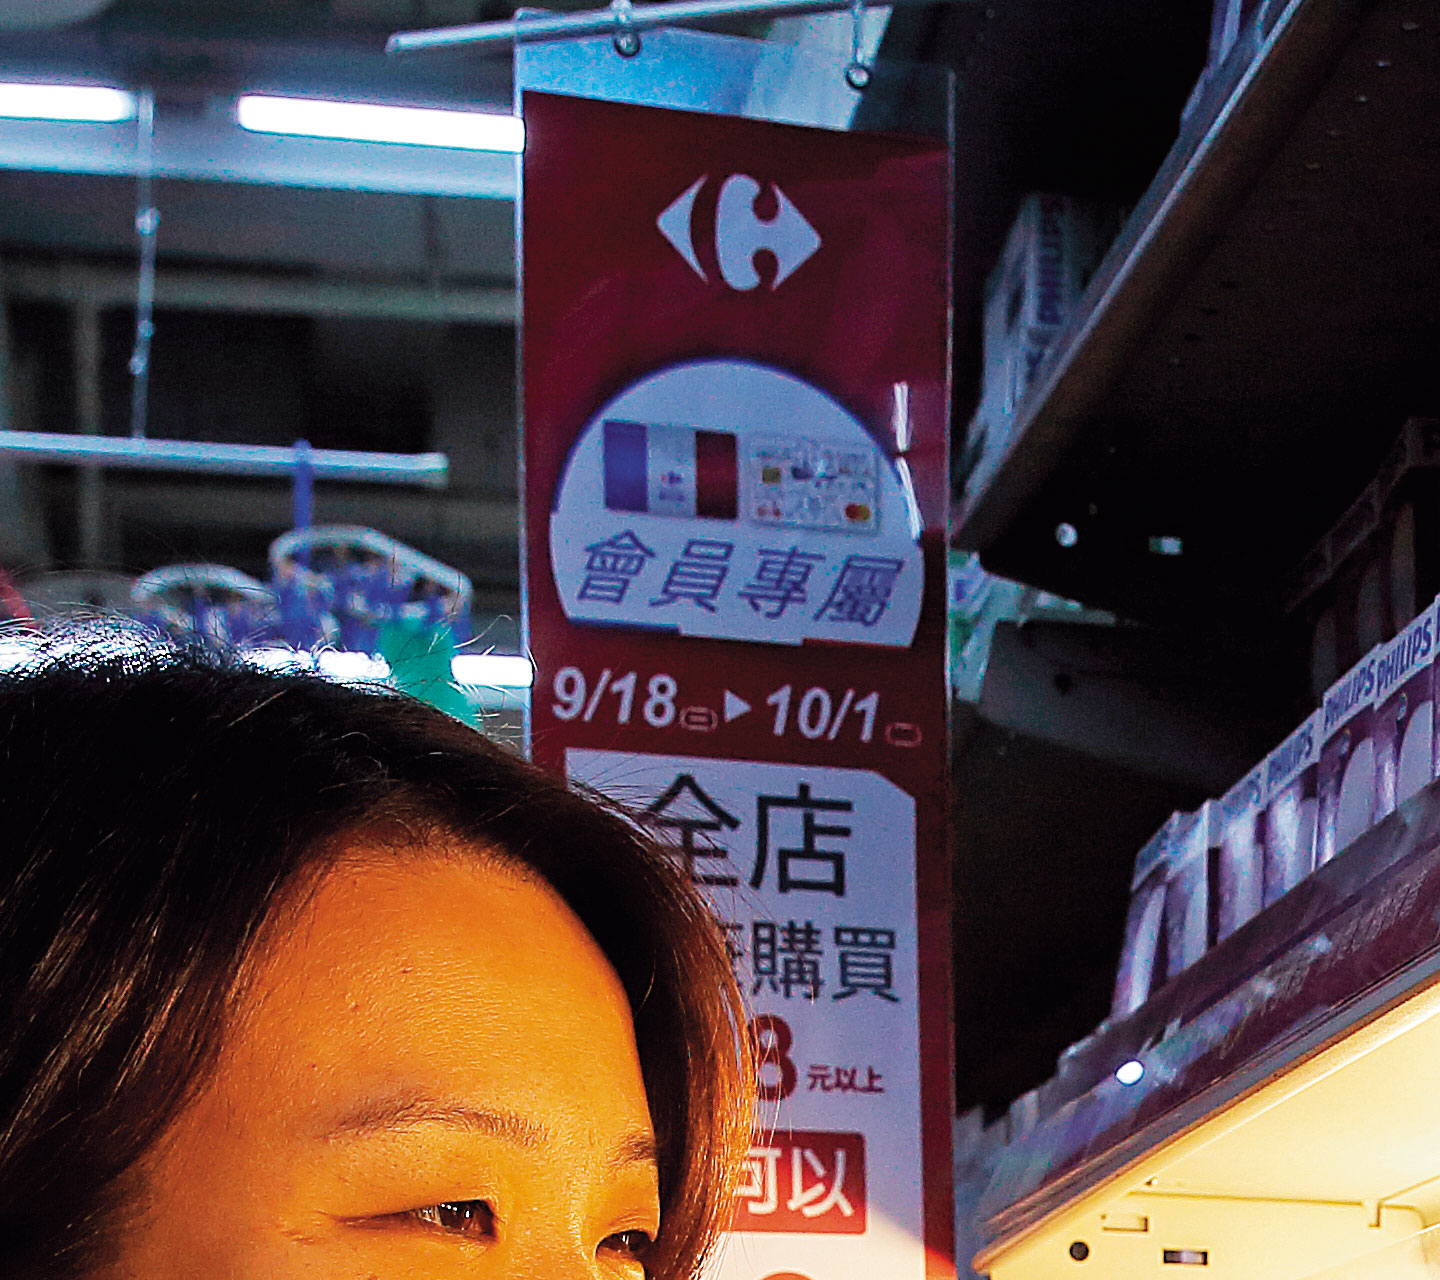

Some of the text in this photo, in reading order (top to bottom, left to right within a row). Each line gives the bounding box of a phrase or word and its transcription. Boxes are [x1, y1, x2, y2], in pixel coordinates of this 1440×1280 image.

[576, 529, 907, 629] 會員專屬
[1377, 617, 1432, 696] PHILIPS
[552, 666, 677, 728] 9/18
[766, 684, 879, 743] 10/1
[647, 773, 854, 897] 全店
[807, 1064, 885, 1096] 元以上
[735, 1147, 854, 1217] 可以
